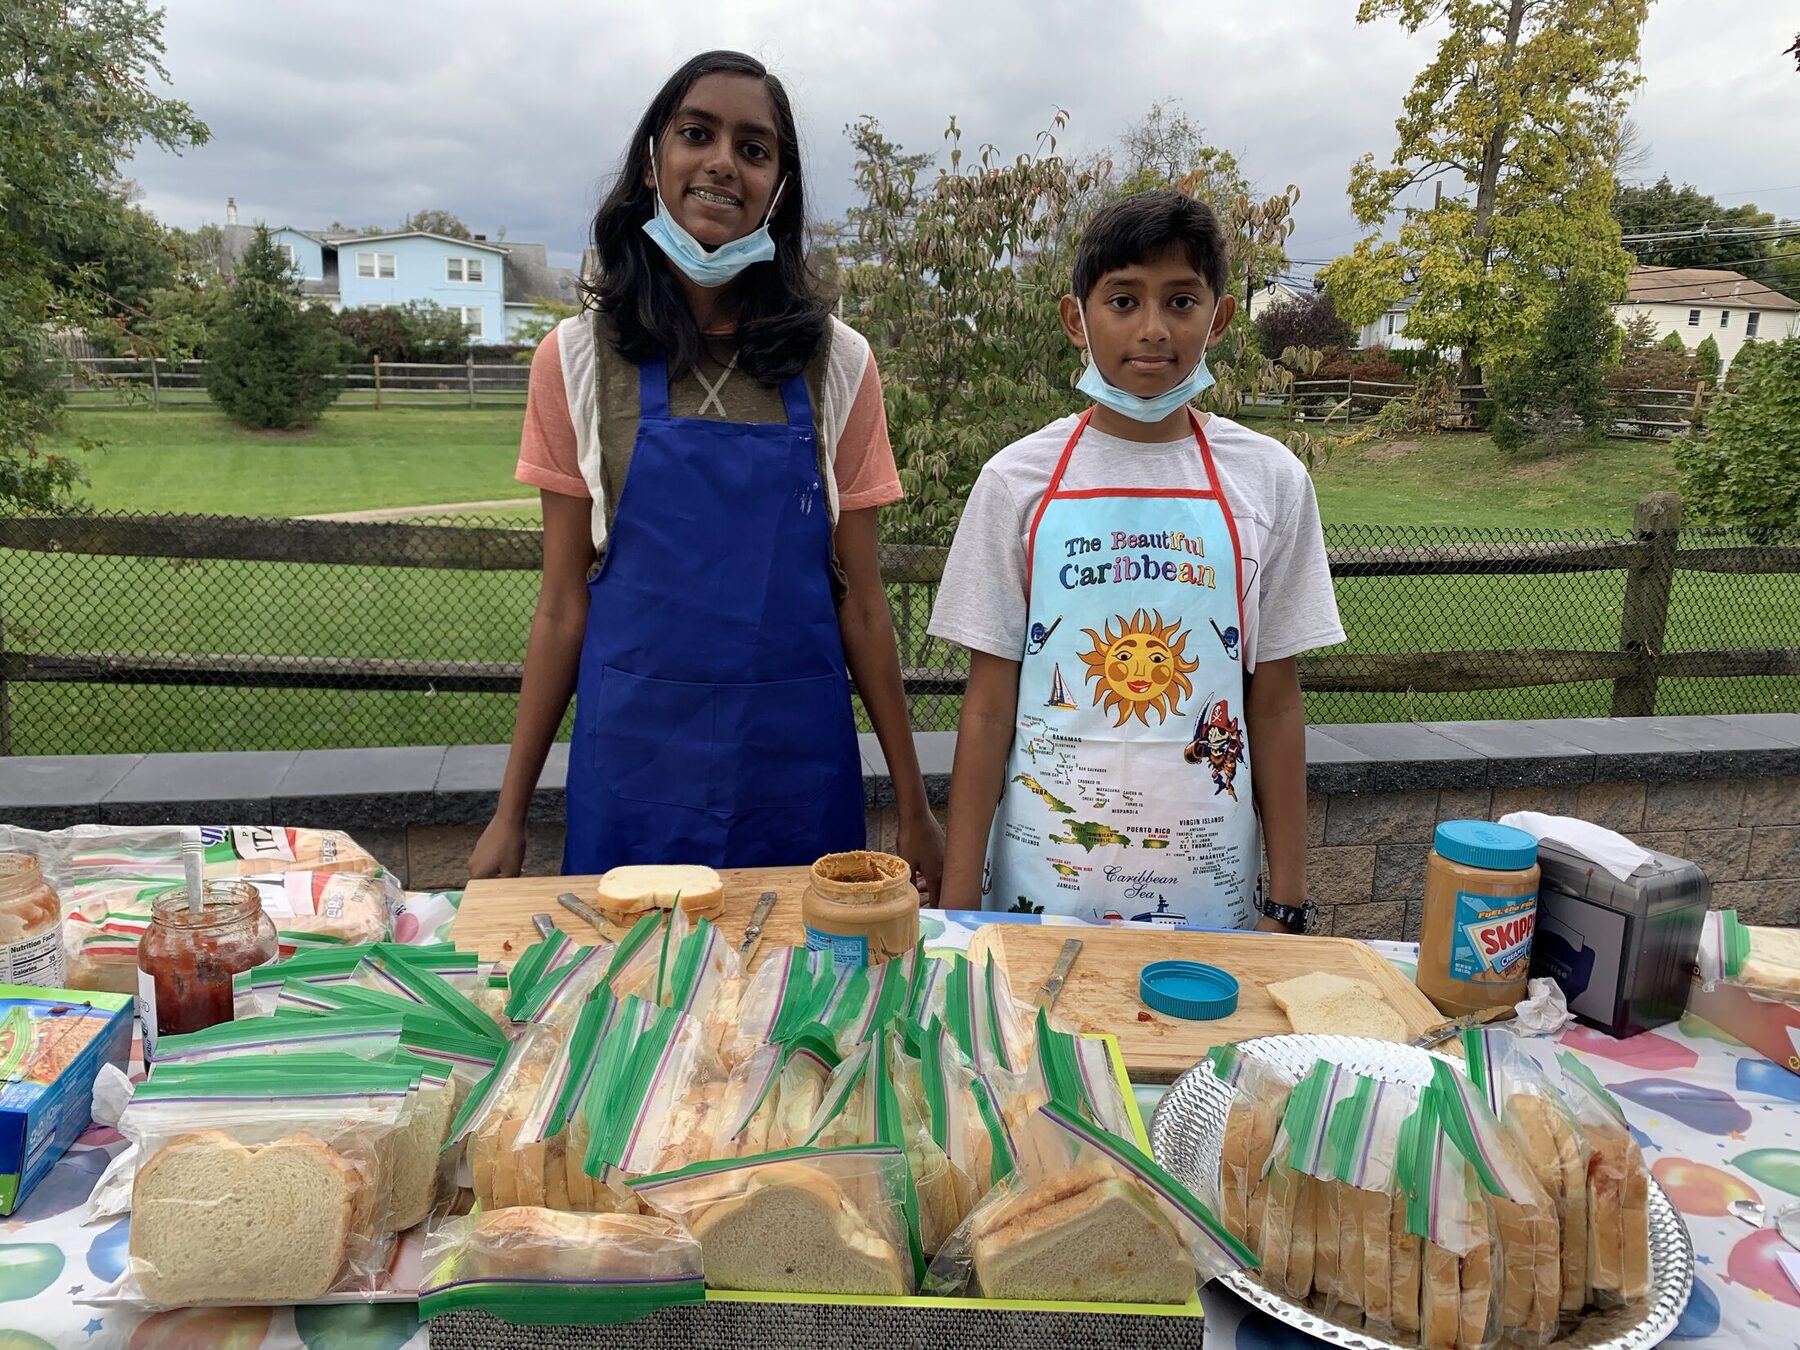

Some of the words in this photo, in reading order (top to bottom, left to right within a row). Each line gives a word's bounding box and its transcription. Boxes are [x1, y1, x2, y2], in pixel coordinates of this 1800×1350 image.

[1065, 537, 1101, 557] The
[1110, 530, 1205, 558] Beautiful
[1059, 554, 1216, 590] Caribbean
[1032, 787, 1048, 796] CUBA
[1180, 818, 1200, 826] VIRGIN
[1126, 826, 1152, 834] PUERTO
[1103, 865, 1180, 884] Caribbean
[1056, 882, 1081, 891] JAMAICA
[1124, 883, 1155, 899] Sea
[10, 940, 42, 953] Nutrition
[12, 965, 37, 977] Calories
